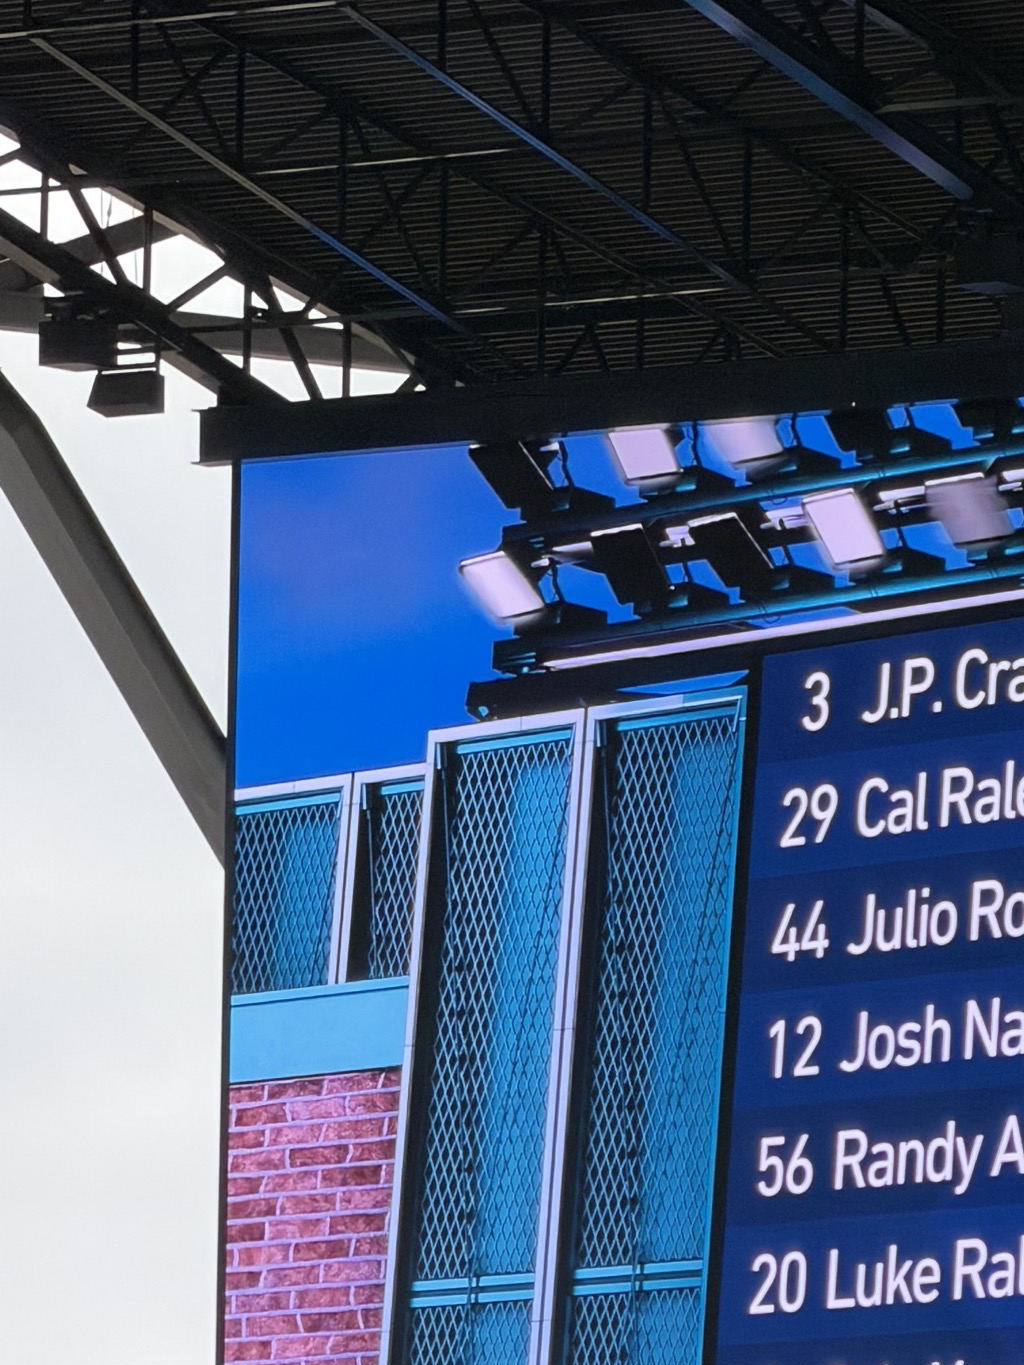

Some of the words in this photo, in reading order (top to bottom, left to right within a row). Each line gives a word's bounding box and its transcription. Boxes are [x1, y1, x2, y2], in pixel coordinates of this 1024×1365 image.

[801, 670, 831, 733] 3
[860, 656, 944, 724] J.P.
[778, 782, 839, 849] 29
[856, 770, 930, 839] Cal
[770, 899, 830, 963] 44
[846, 886, 959, 956] Julio
[768, 1014, 823, 1080] 12
[838, 1003, 952, 1074] Josh
[757, 1132, 815, 1198] 56
[833, 1119, 985, 1196] Randy
[748, 1249, 808, 1316] 20
[825, 1243, 942, 1310] Luke
